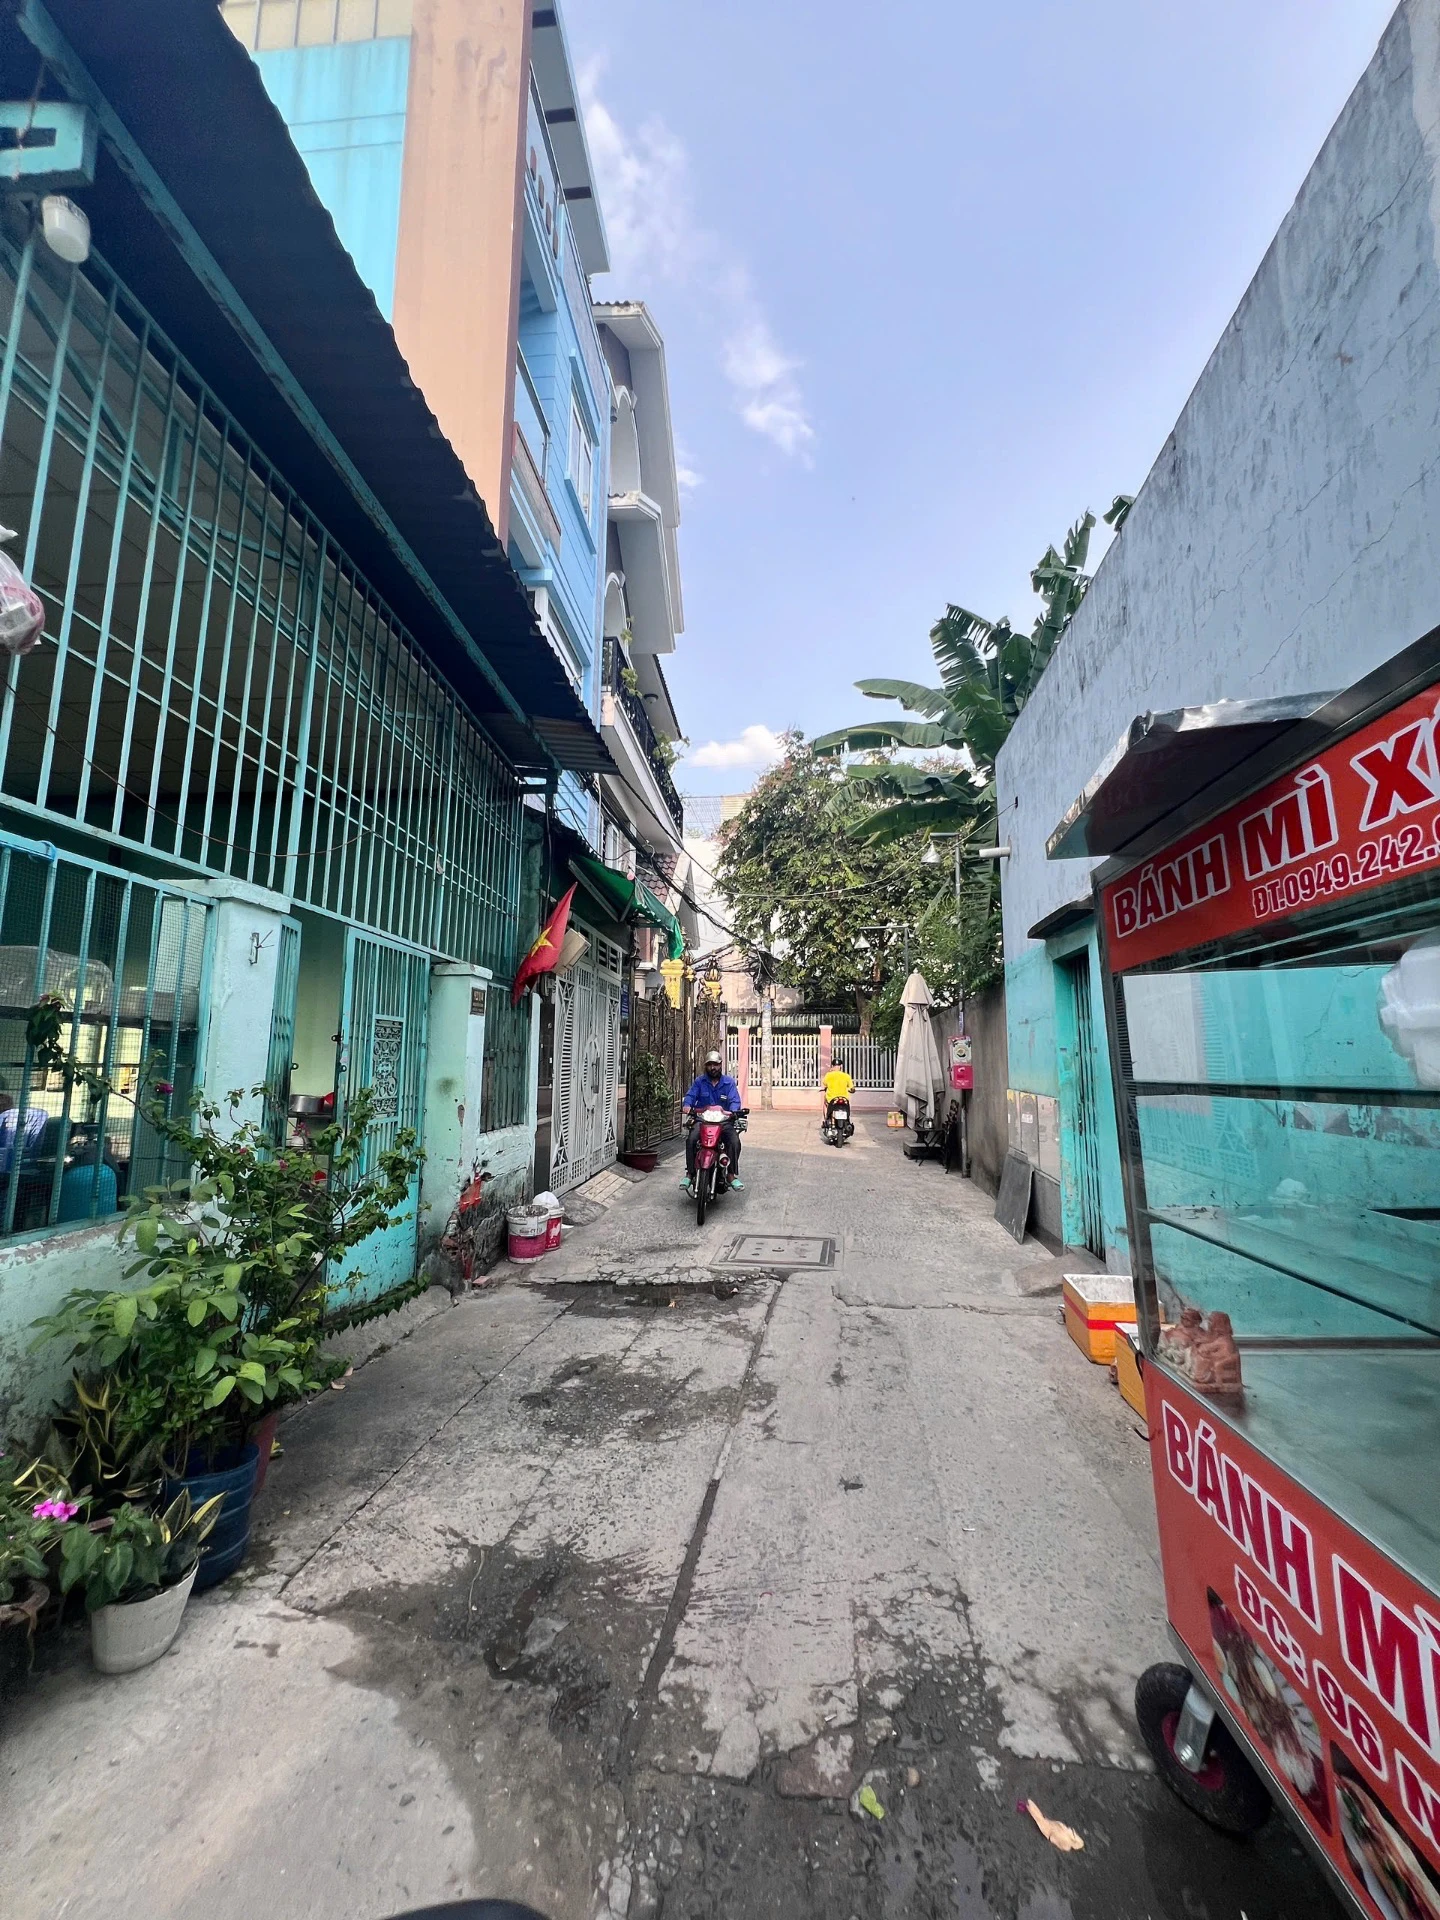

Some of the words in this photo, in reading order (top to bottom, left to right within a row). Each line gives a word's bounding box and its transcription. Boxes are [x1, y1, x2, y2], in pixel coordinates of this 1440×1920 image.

[1113, 834, 1231, 938] BÁNH
[1239, 764, 1338, 881] MÌ
[1350, 700, 1440, 832] X
[1252, 814, 1440, 918] ĐT.0949.242.
[1162, 1399, 1322, 1635] BÁNH
[1313, 1659, 1389, 1783] 96
